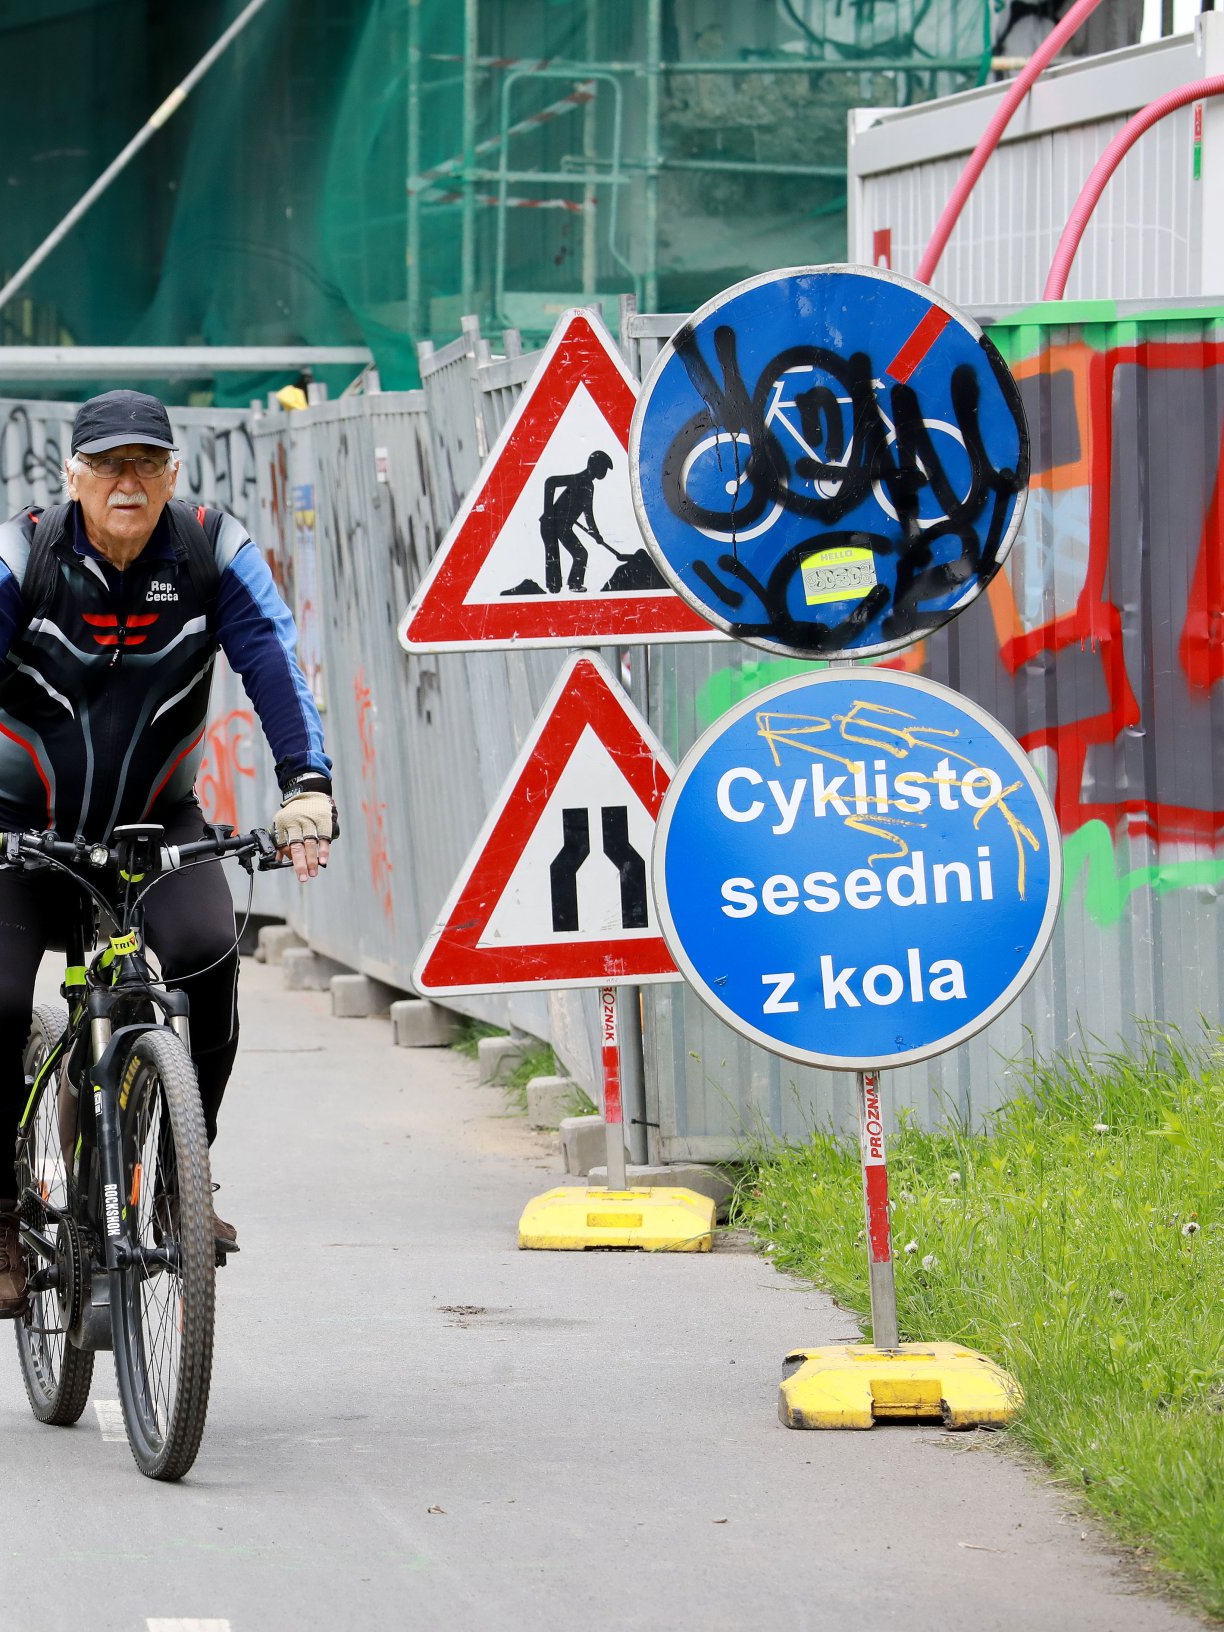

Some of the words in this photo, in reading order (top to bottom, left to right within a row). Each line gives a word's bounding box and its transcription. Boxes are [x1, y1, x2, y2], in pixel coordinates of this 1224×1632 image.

[820, 549, 854, 561] HELLO
[145, 591, 179, 602] Cecca
[151, 580, 176, 593] Rep.
[716, 757, 1003, 834] Cyklisto
[720, 845, 994, 919] sesedni
[761, 972, 800, 1015] z
[819, 947, 968, 1010] kola
